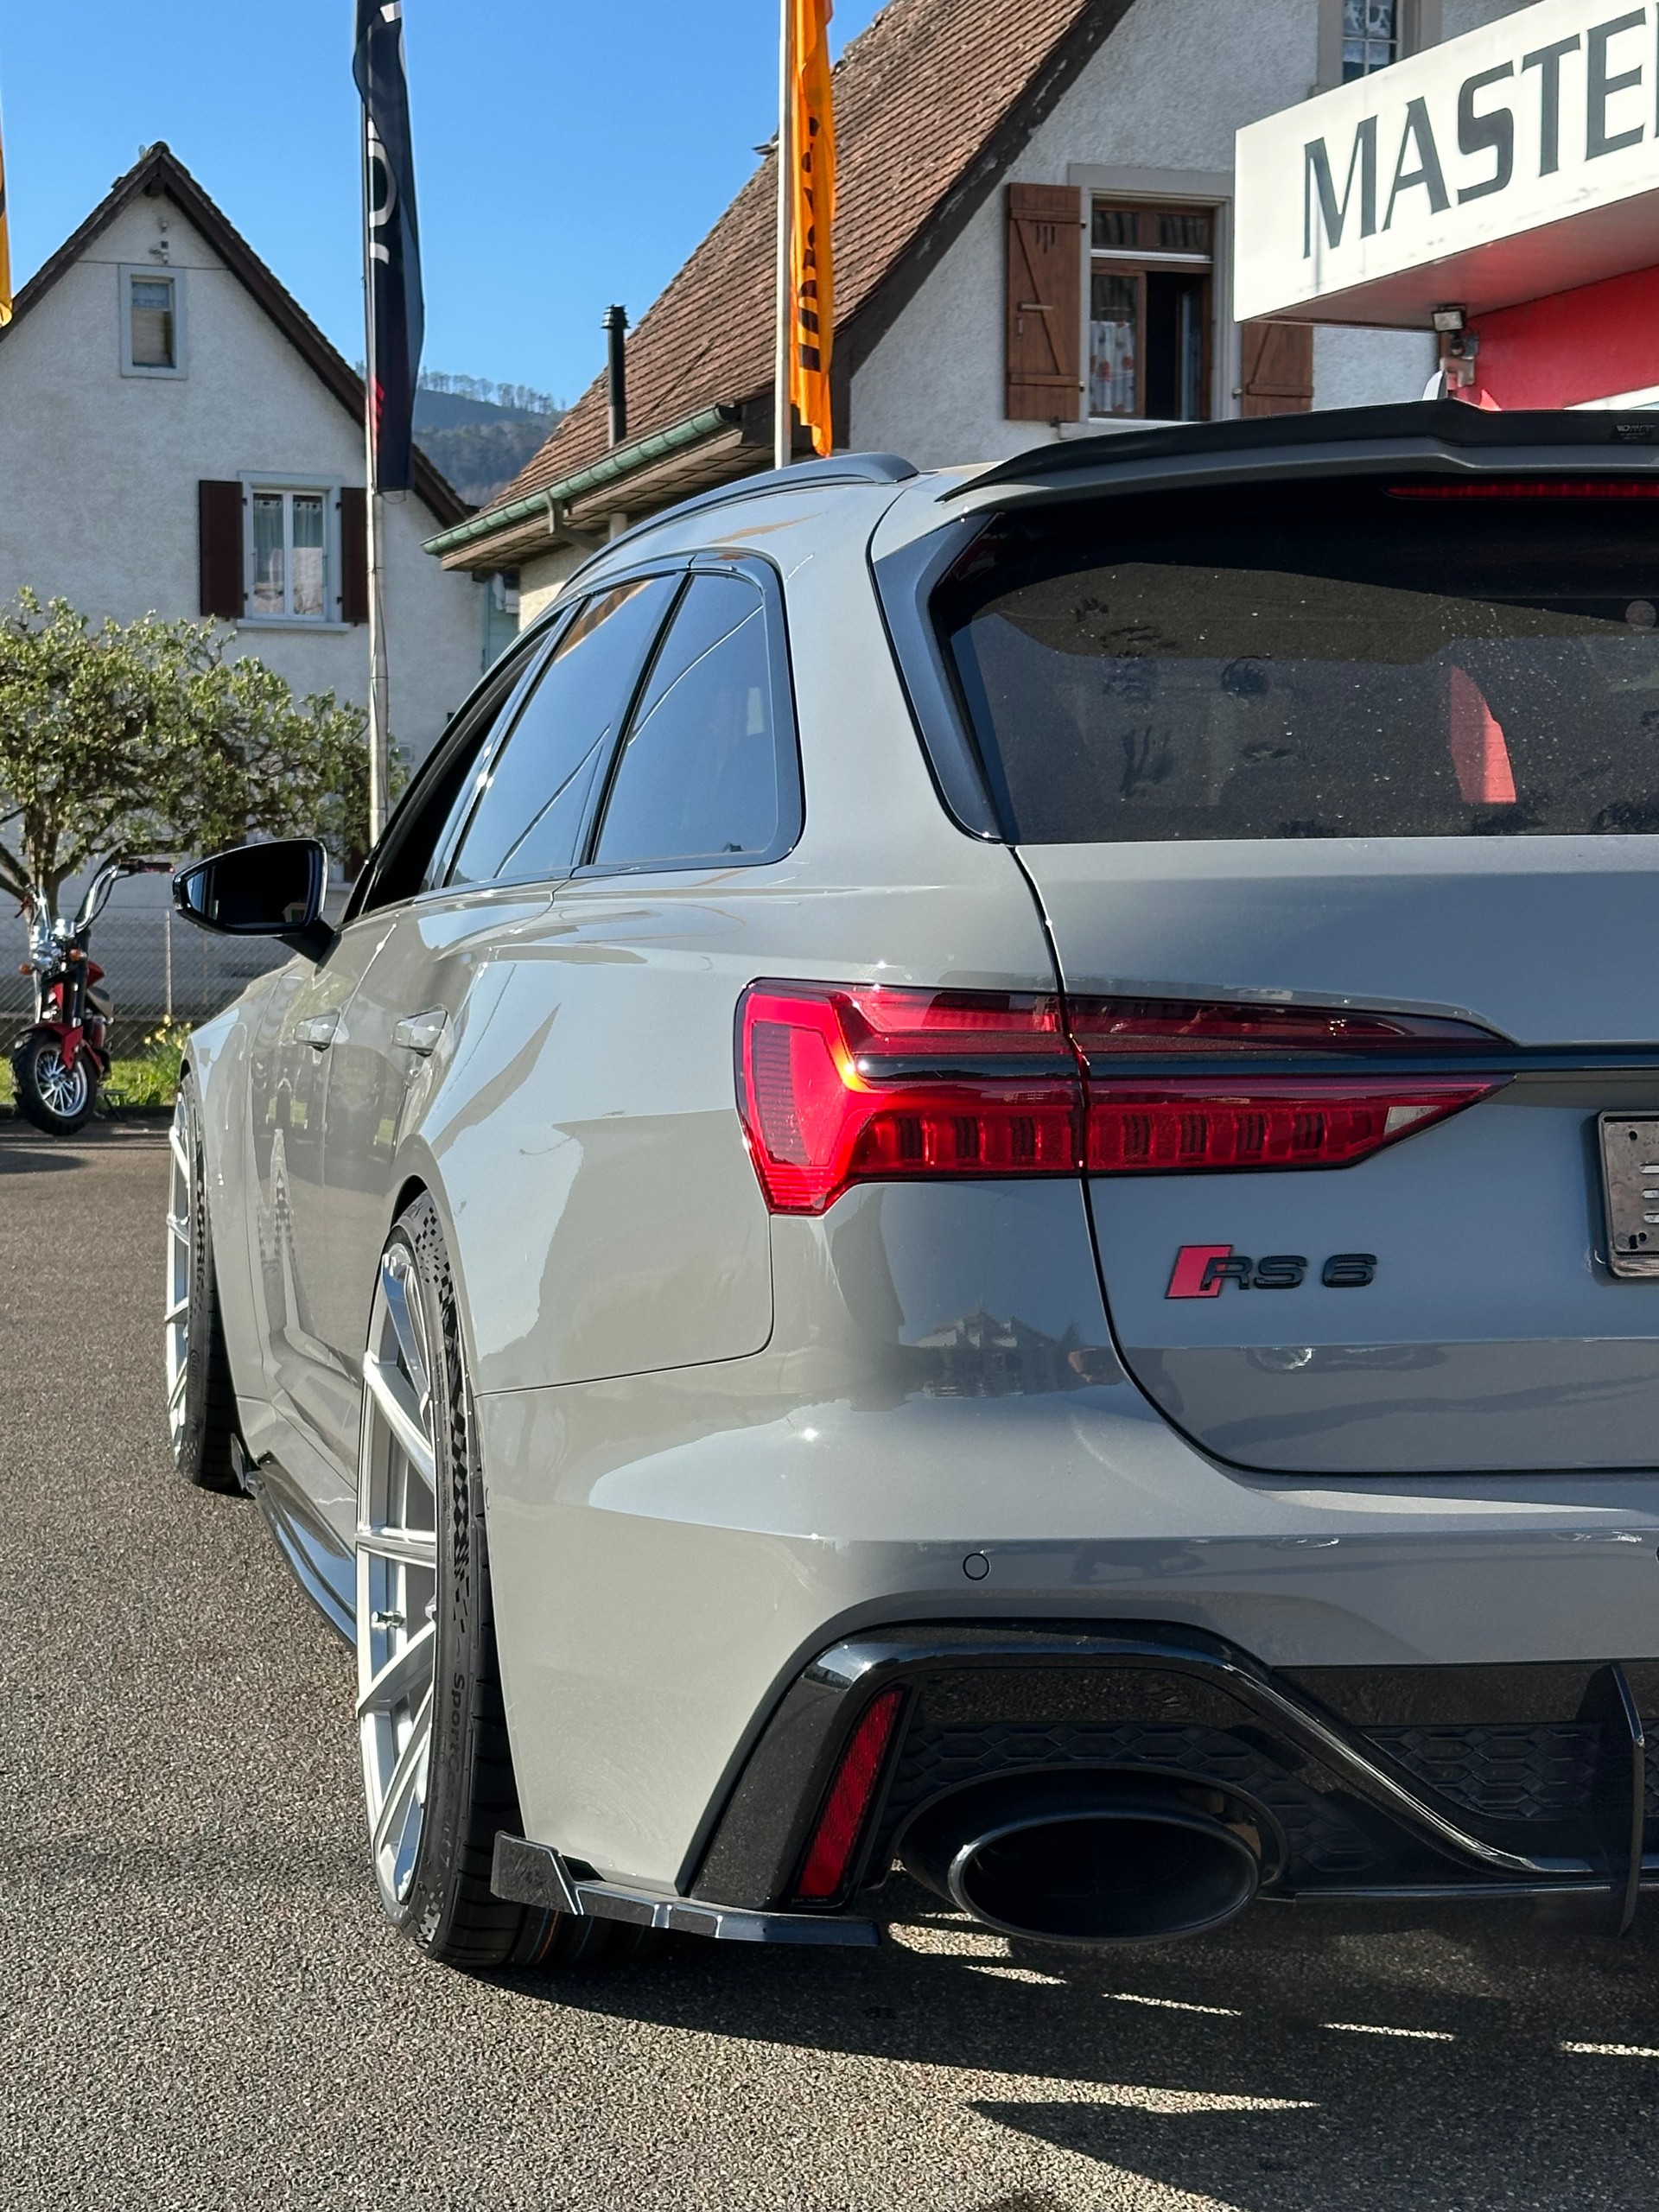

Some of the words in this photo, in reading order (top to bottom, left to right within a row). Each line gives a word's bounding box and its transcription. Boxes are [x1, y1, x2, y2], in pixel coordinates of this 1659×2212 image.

[1302, 2, 1659, 260] MASTE
[1199, 1255, 1308, 1291] RS
[1322, 1253, 1378, 1288] 6
[442, 1672, 465, 1848] SportCo
